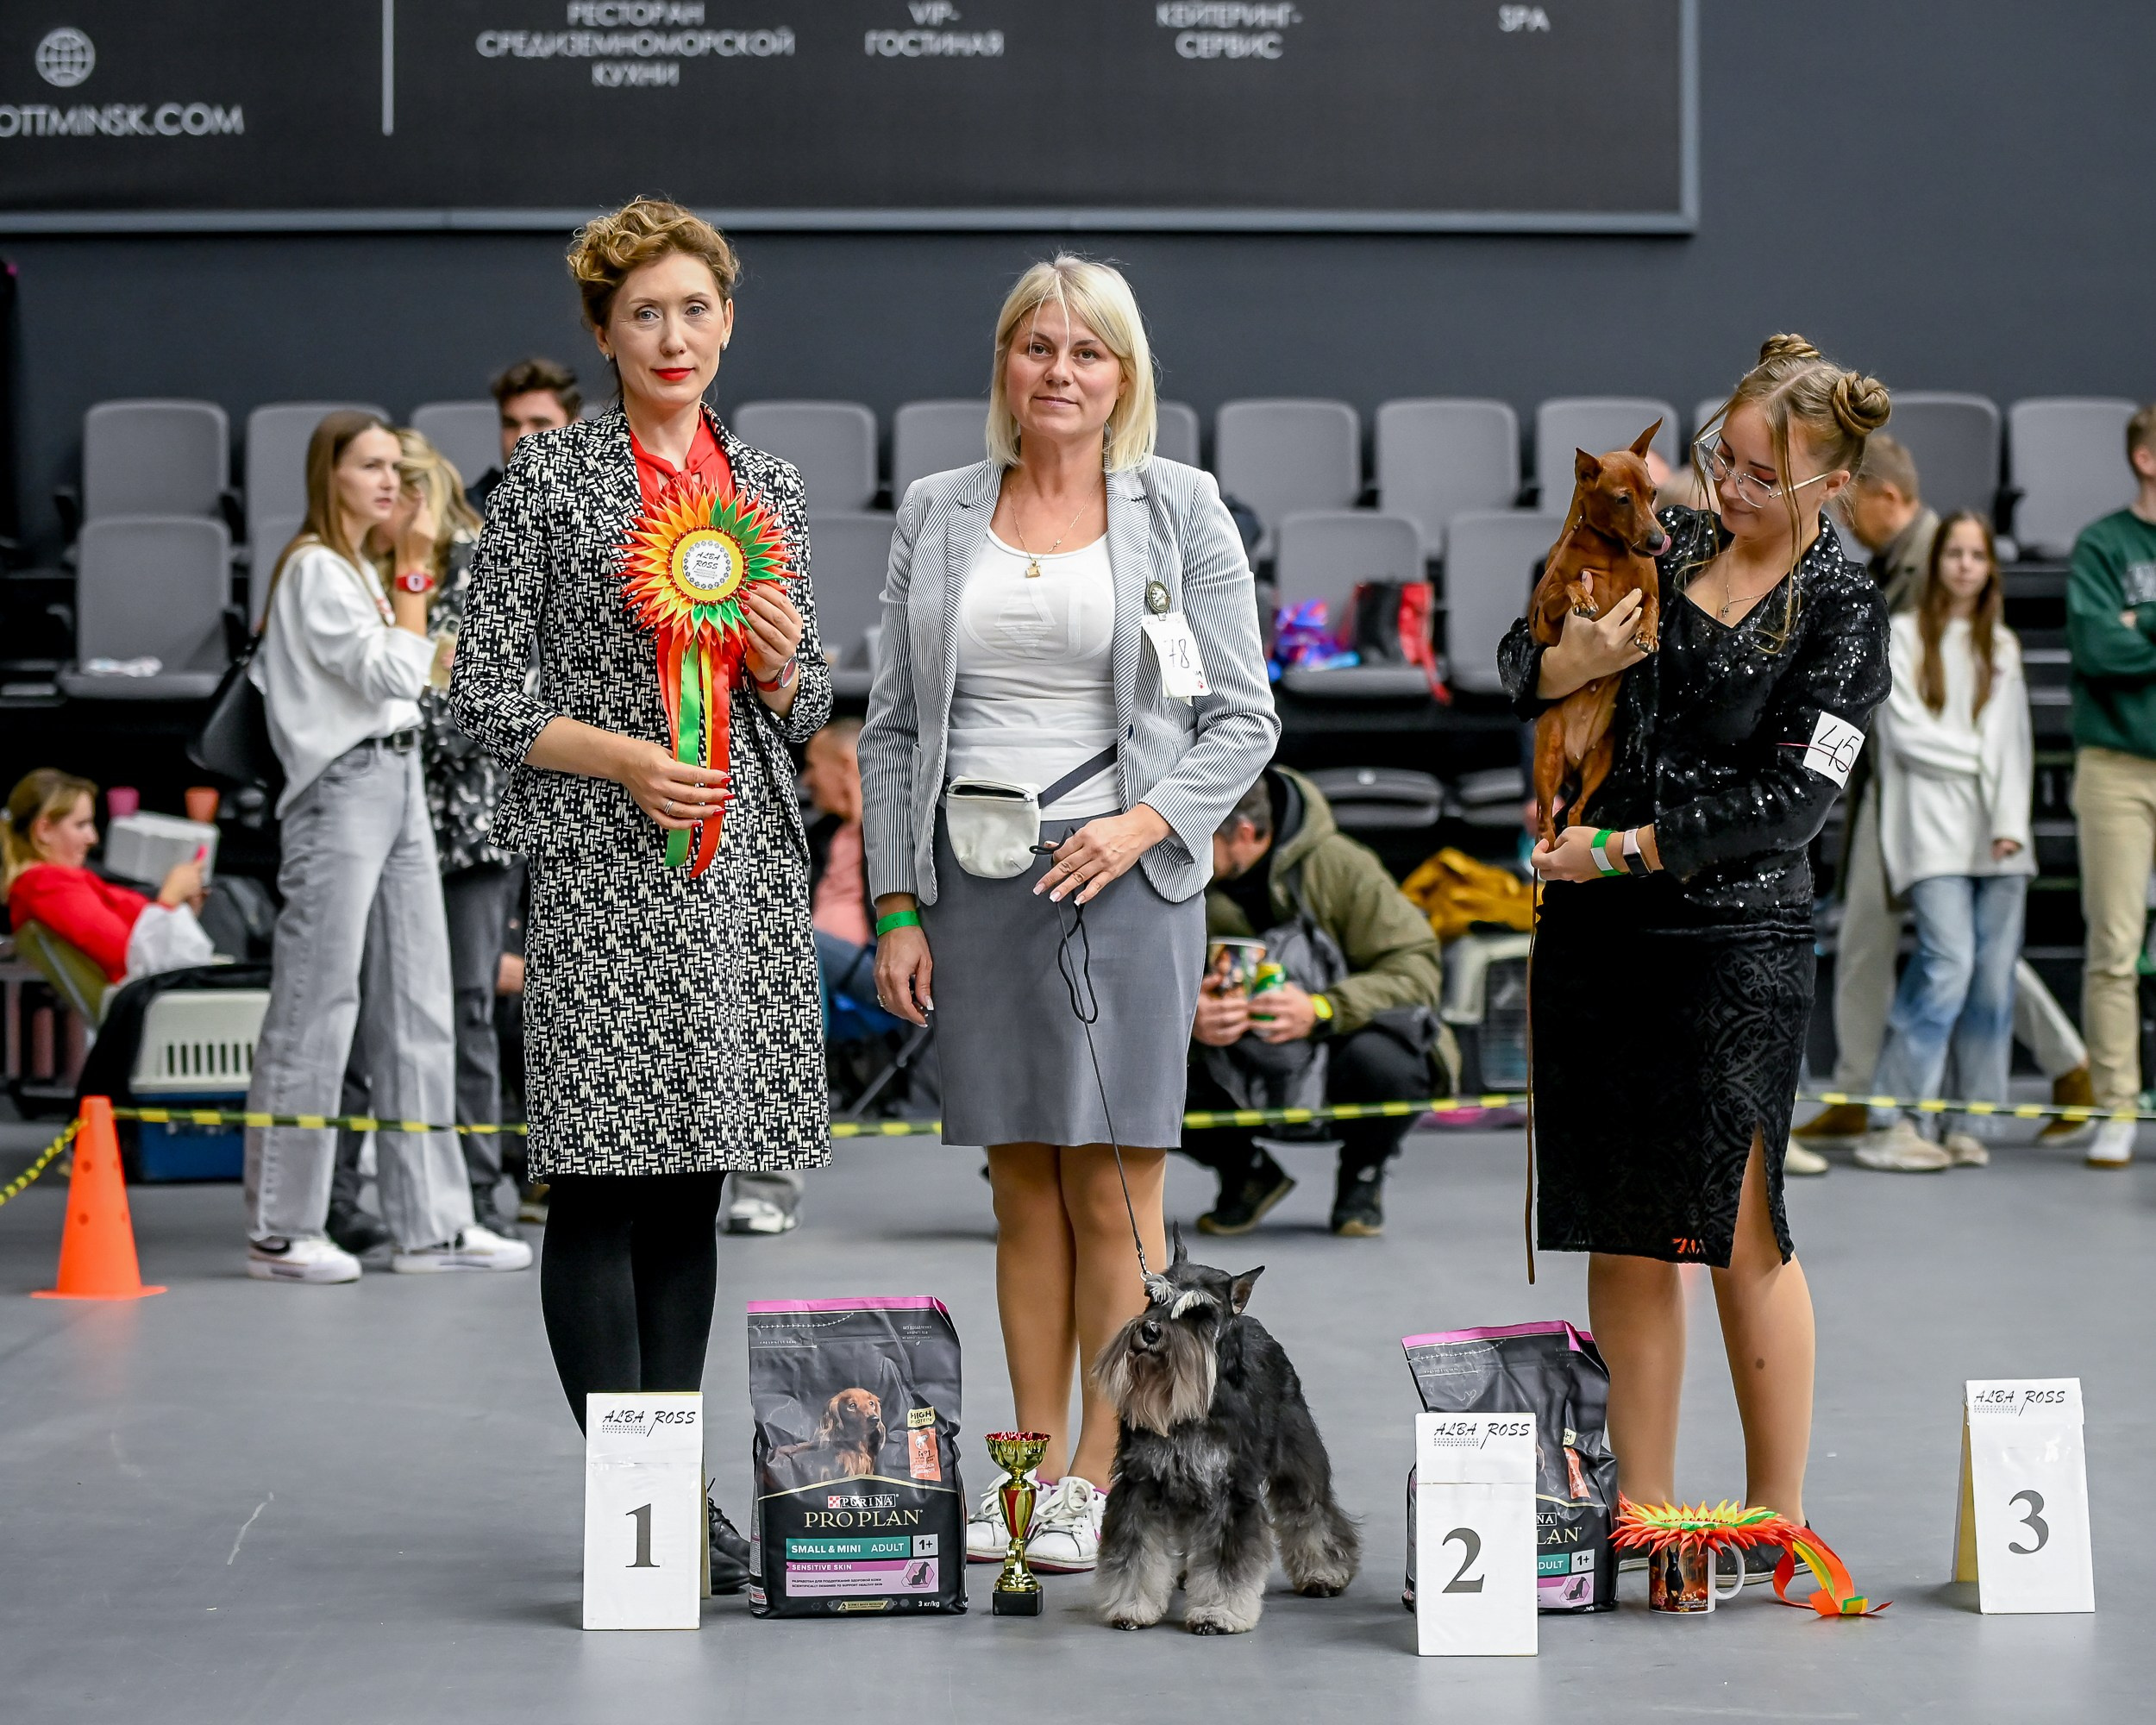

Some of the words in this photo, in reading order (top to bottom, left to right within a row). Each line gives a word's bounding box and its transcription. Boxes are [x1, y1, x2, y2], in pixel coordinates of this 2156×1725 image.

[567, 0, 705, 26] РЕСТОРАН
[1499, 5, 1550, 32] SPA
[476, 26, 795, 57] СРЕДИЗЕМНОМОРСКОЙ
[864, 30, 1005, 57] ГОСТИНАЯ
[1175, 31, 1283, 59] СЕРВИС
[592, 61, 680, 87] КУХНИ
[692, 560, 718, 570] ROSS
[1818, 724, 1859, 773] 45
[911, 1410, 932, 1420] HIGH
[1974, 1390, 2015, 1403] ALBA
[2018, 1390, 2065, 1416] ROSS
[602, 1409, 645, 1423] ALBA
[646, 1410, 696, 1437] ROSS
[1433, 1422, 1477, 1435] ALBA
[1480, 1422, 1531, 1450] ROSS
[841, 1495, 893, 1508] PURINA
[804, 1511, 854, 1527] PRO
[857, 1509, 920, 1527] PLAN
[2009, 1490, 2049, 1554] 3
[625, 1503, 661, 1568] 1
[791, 1545, 826, 1553] SMALL
[871, 1543, 905, 1552] ADULT
[918, 1540, 933, 1551] 1+
[1537, 1527, 1579, 1545] LAN
[1441, 1527, 1485, 1594] 2
[1538, 1560, 1564, 1570] DULT
[1577, 1555, 1589, 1566] 1+
